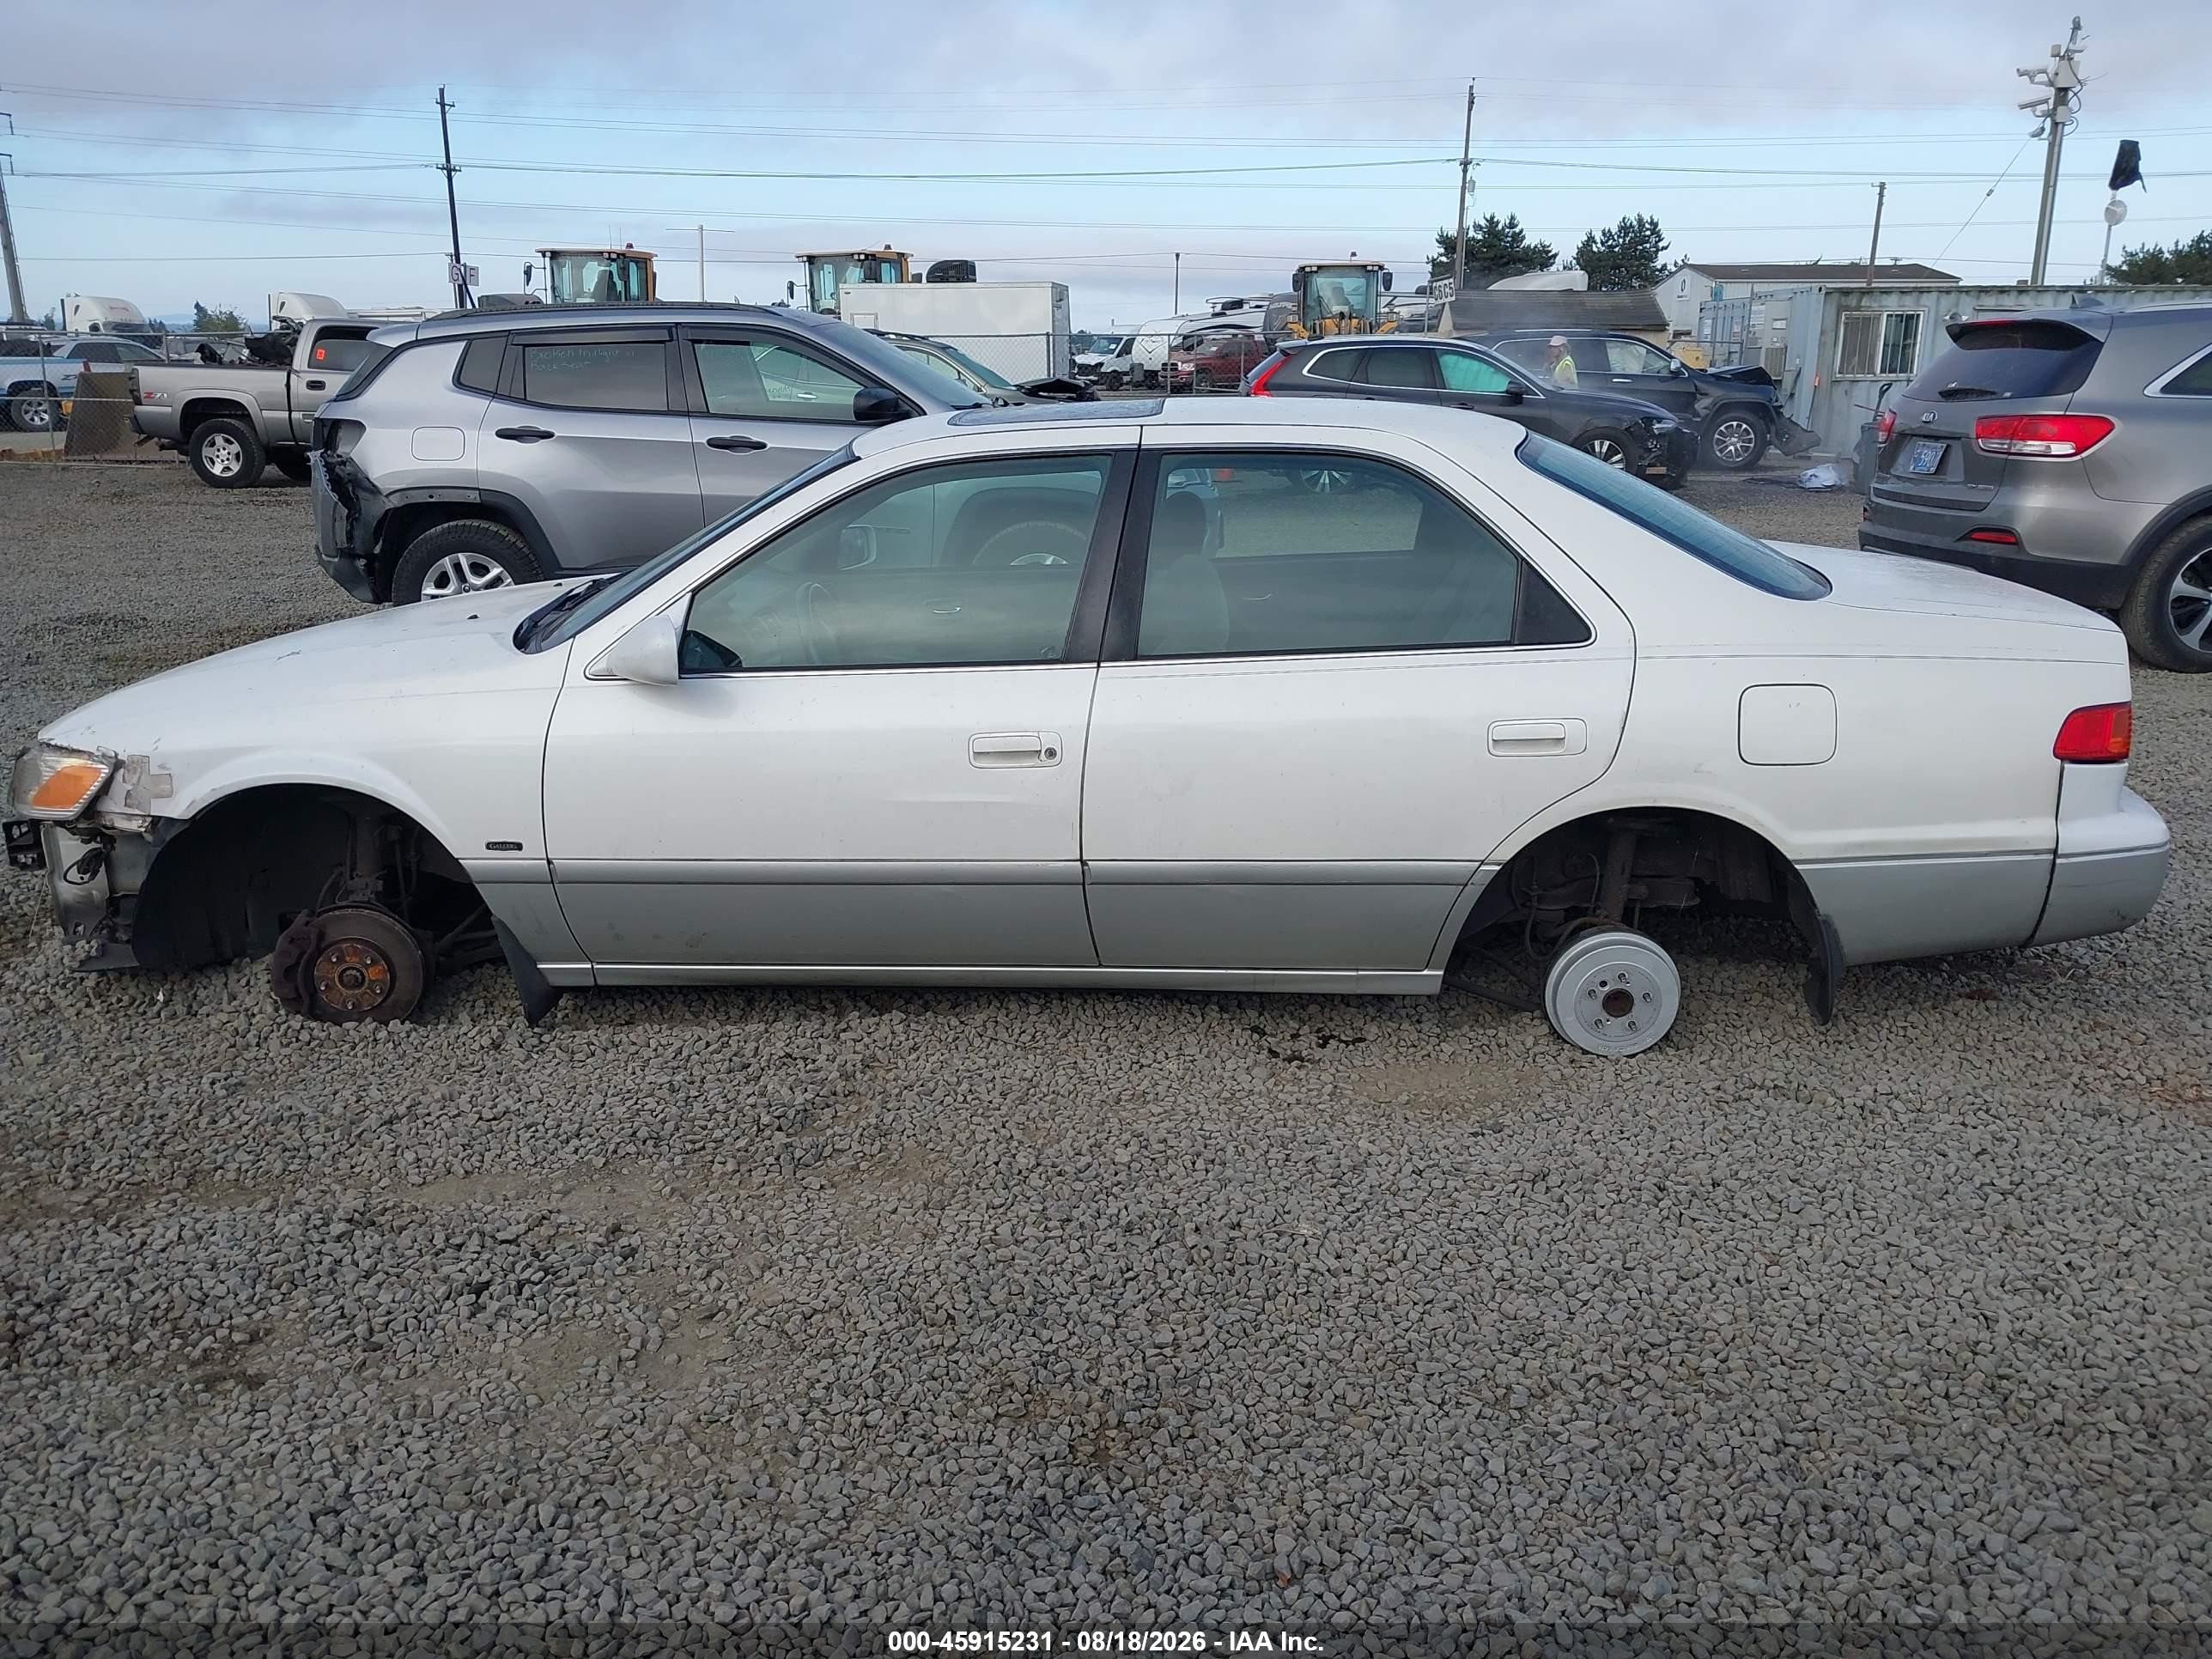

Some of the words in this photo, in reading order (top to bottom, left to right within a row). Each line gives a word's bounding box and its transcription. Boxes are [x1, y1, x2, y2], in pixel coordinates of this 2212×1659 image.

[451, 264, 459, 283] G
[469, 267, 477, 284] F
[1443, 283, 1454, 299] C5
